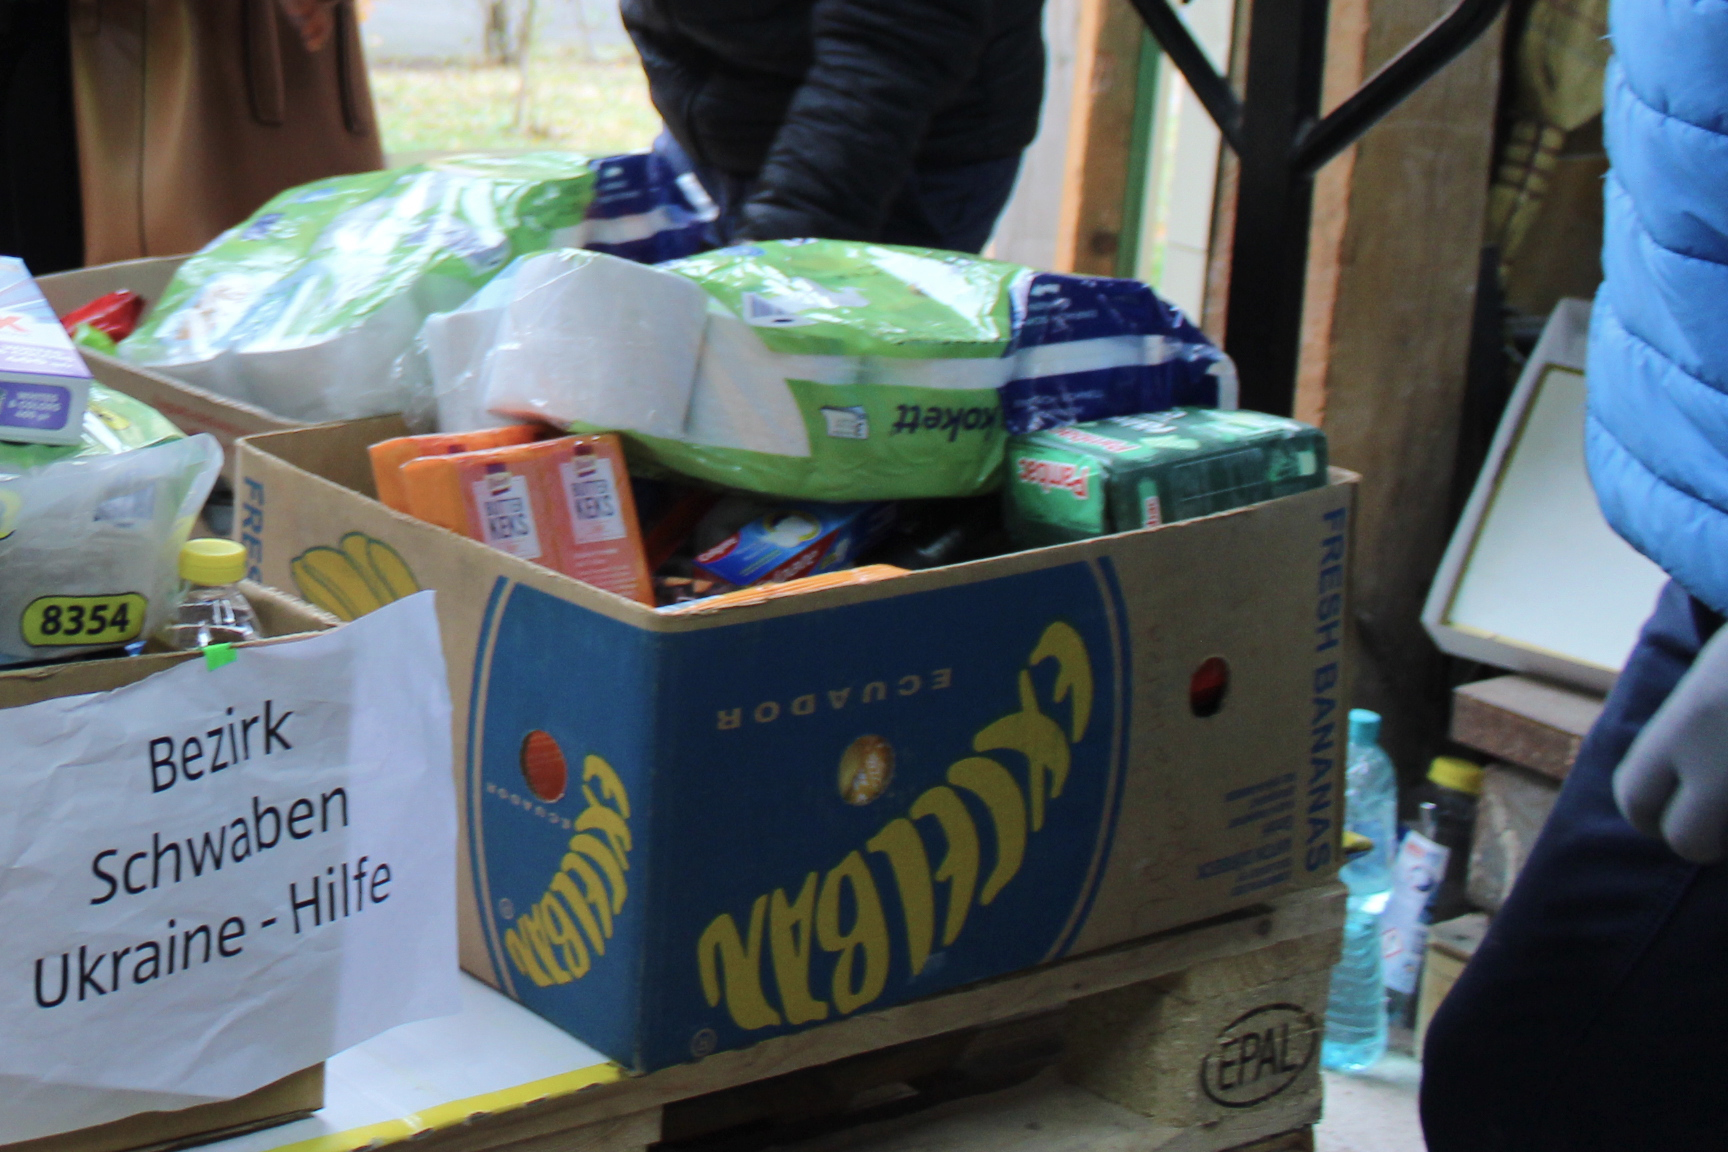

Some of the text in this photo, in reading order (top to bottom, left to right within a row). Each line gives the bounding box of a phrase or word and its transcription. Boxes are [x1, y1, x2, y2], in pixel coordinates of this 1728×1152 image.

[39, 601, 131, 637] 8354
[716, 666, 954, 732] ECUADOR
[1304, 507, 1347, 874] FRESH BANANAS
[148, 699, 294, 794] Bezirk
[89, 786, 350, 906] Schwaben
[33, 914, 247, 1009] Ukraine
[288, 855, 393, 935] Hilfe
[1218, 1022, 1299, 1091] EPAL
